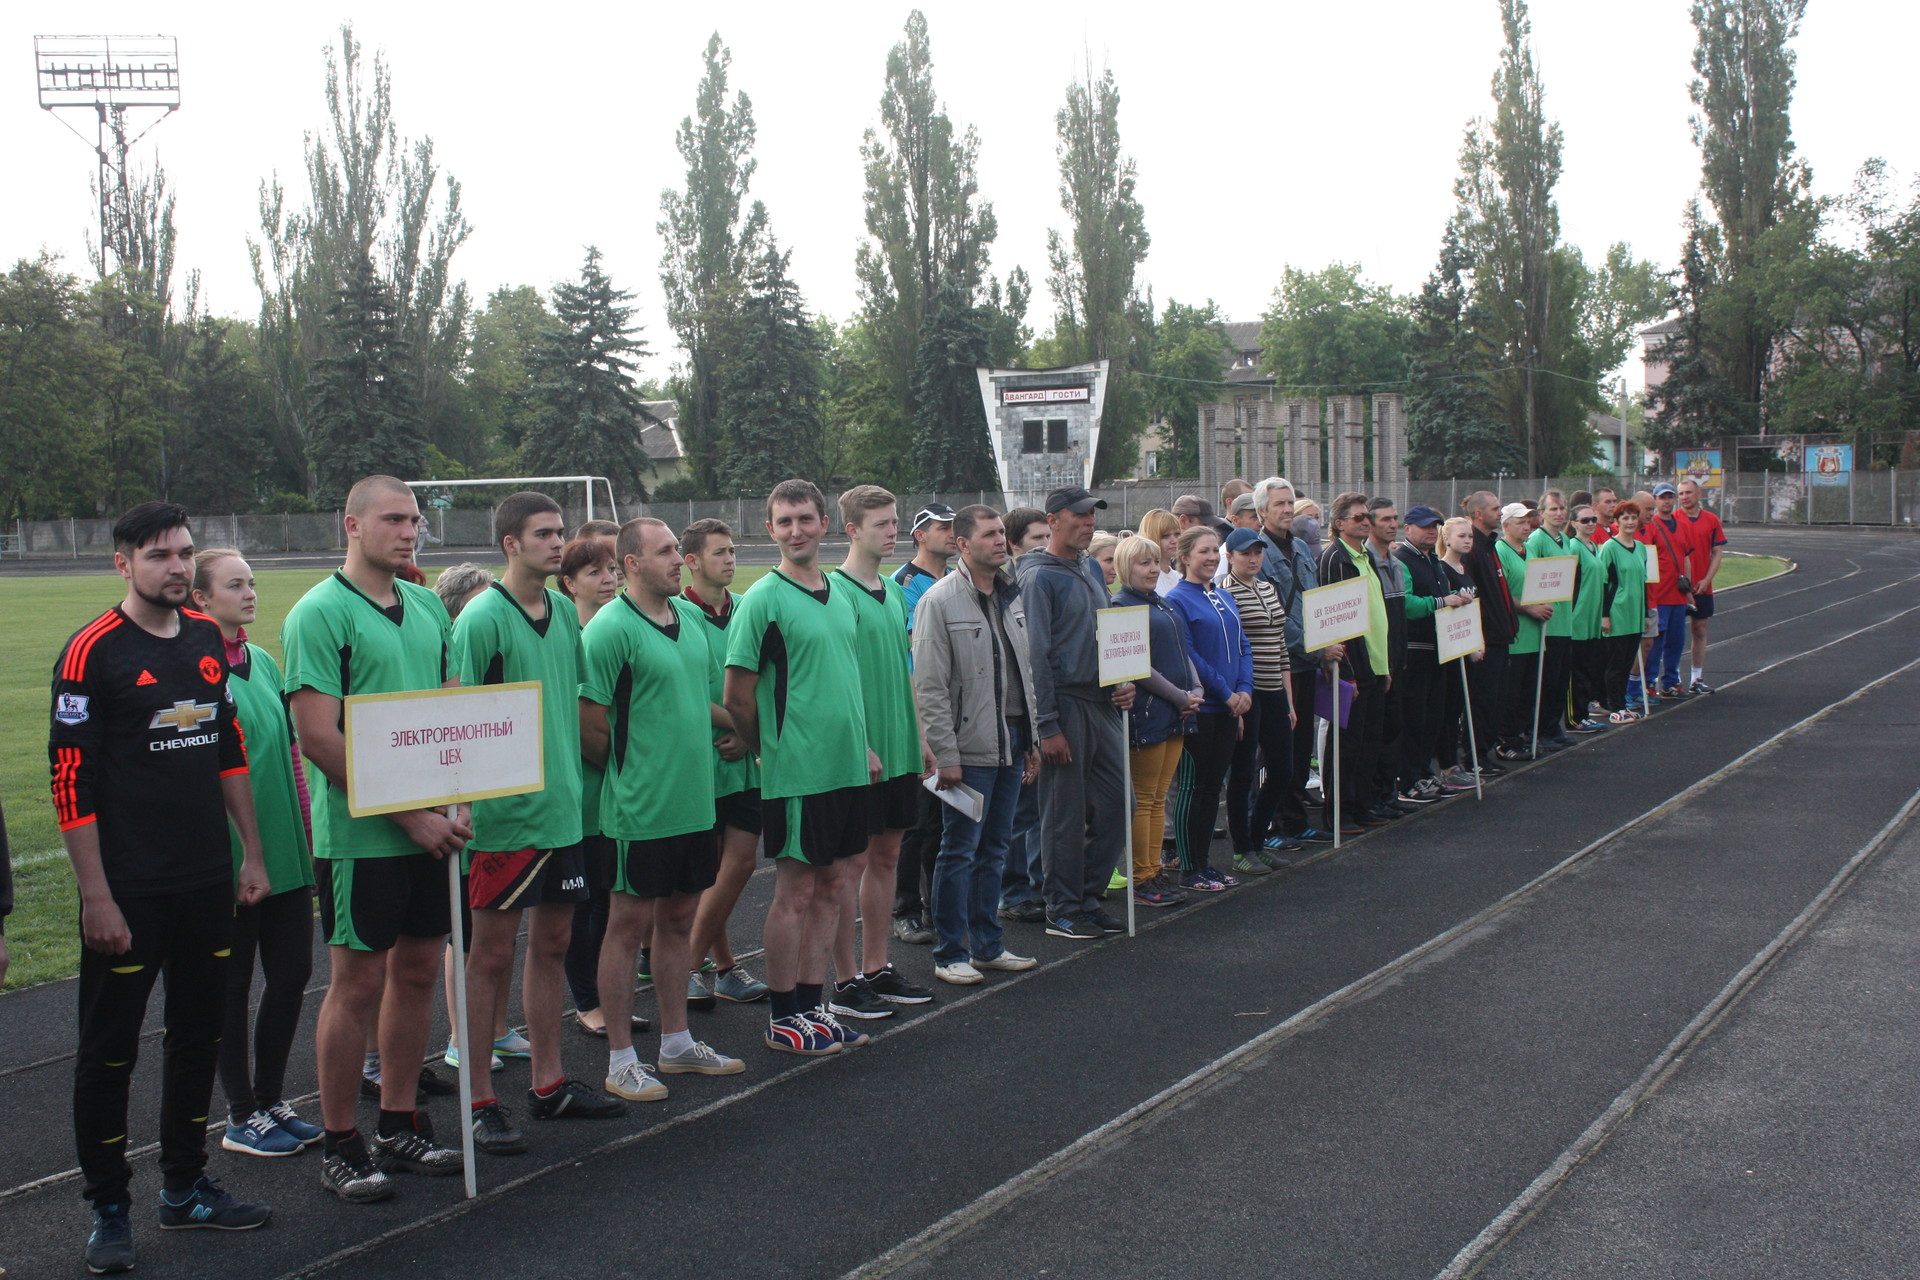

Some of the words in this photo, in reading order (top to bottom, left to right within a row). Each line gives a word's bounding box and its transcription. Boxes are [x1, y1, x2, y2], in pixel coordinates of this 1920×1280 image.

[1005, 393, 1044, 401] АВАНГАРД
[1053, 391, 1080, 399] ГОСТИ
[391, 716, 513, 747] ЭЛЕКТРОРЕМОНТНЫЙ
[150, 733, 219, 751] CHEVROLET
[440, 748, 462, 766] ЦЕХ
